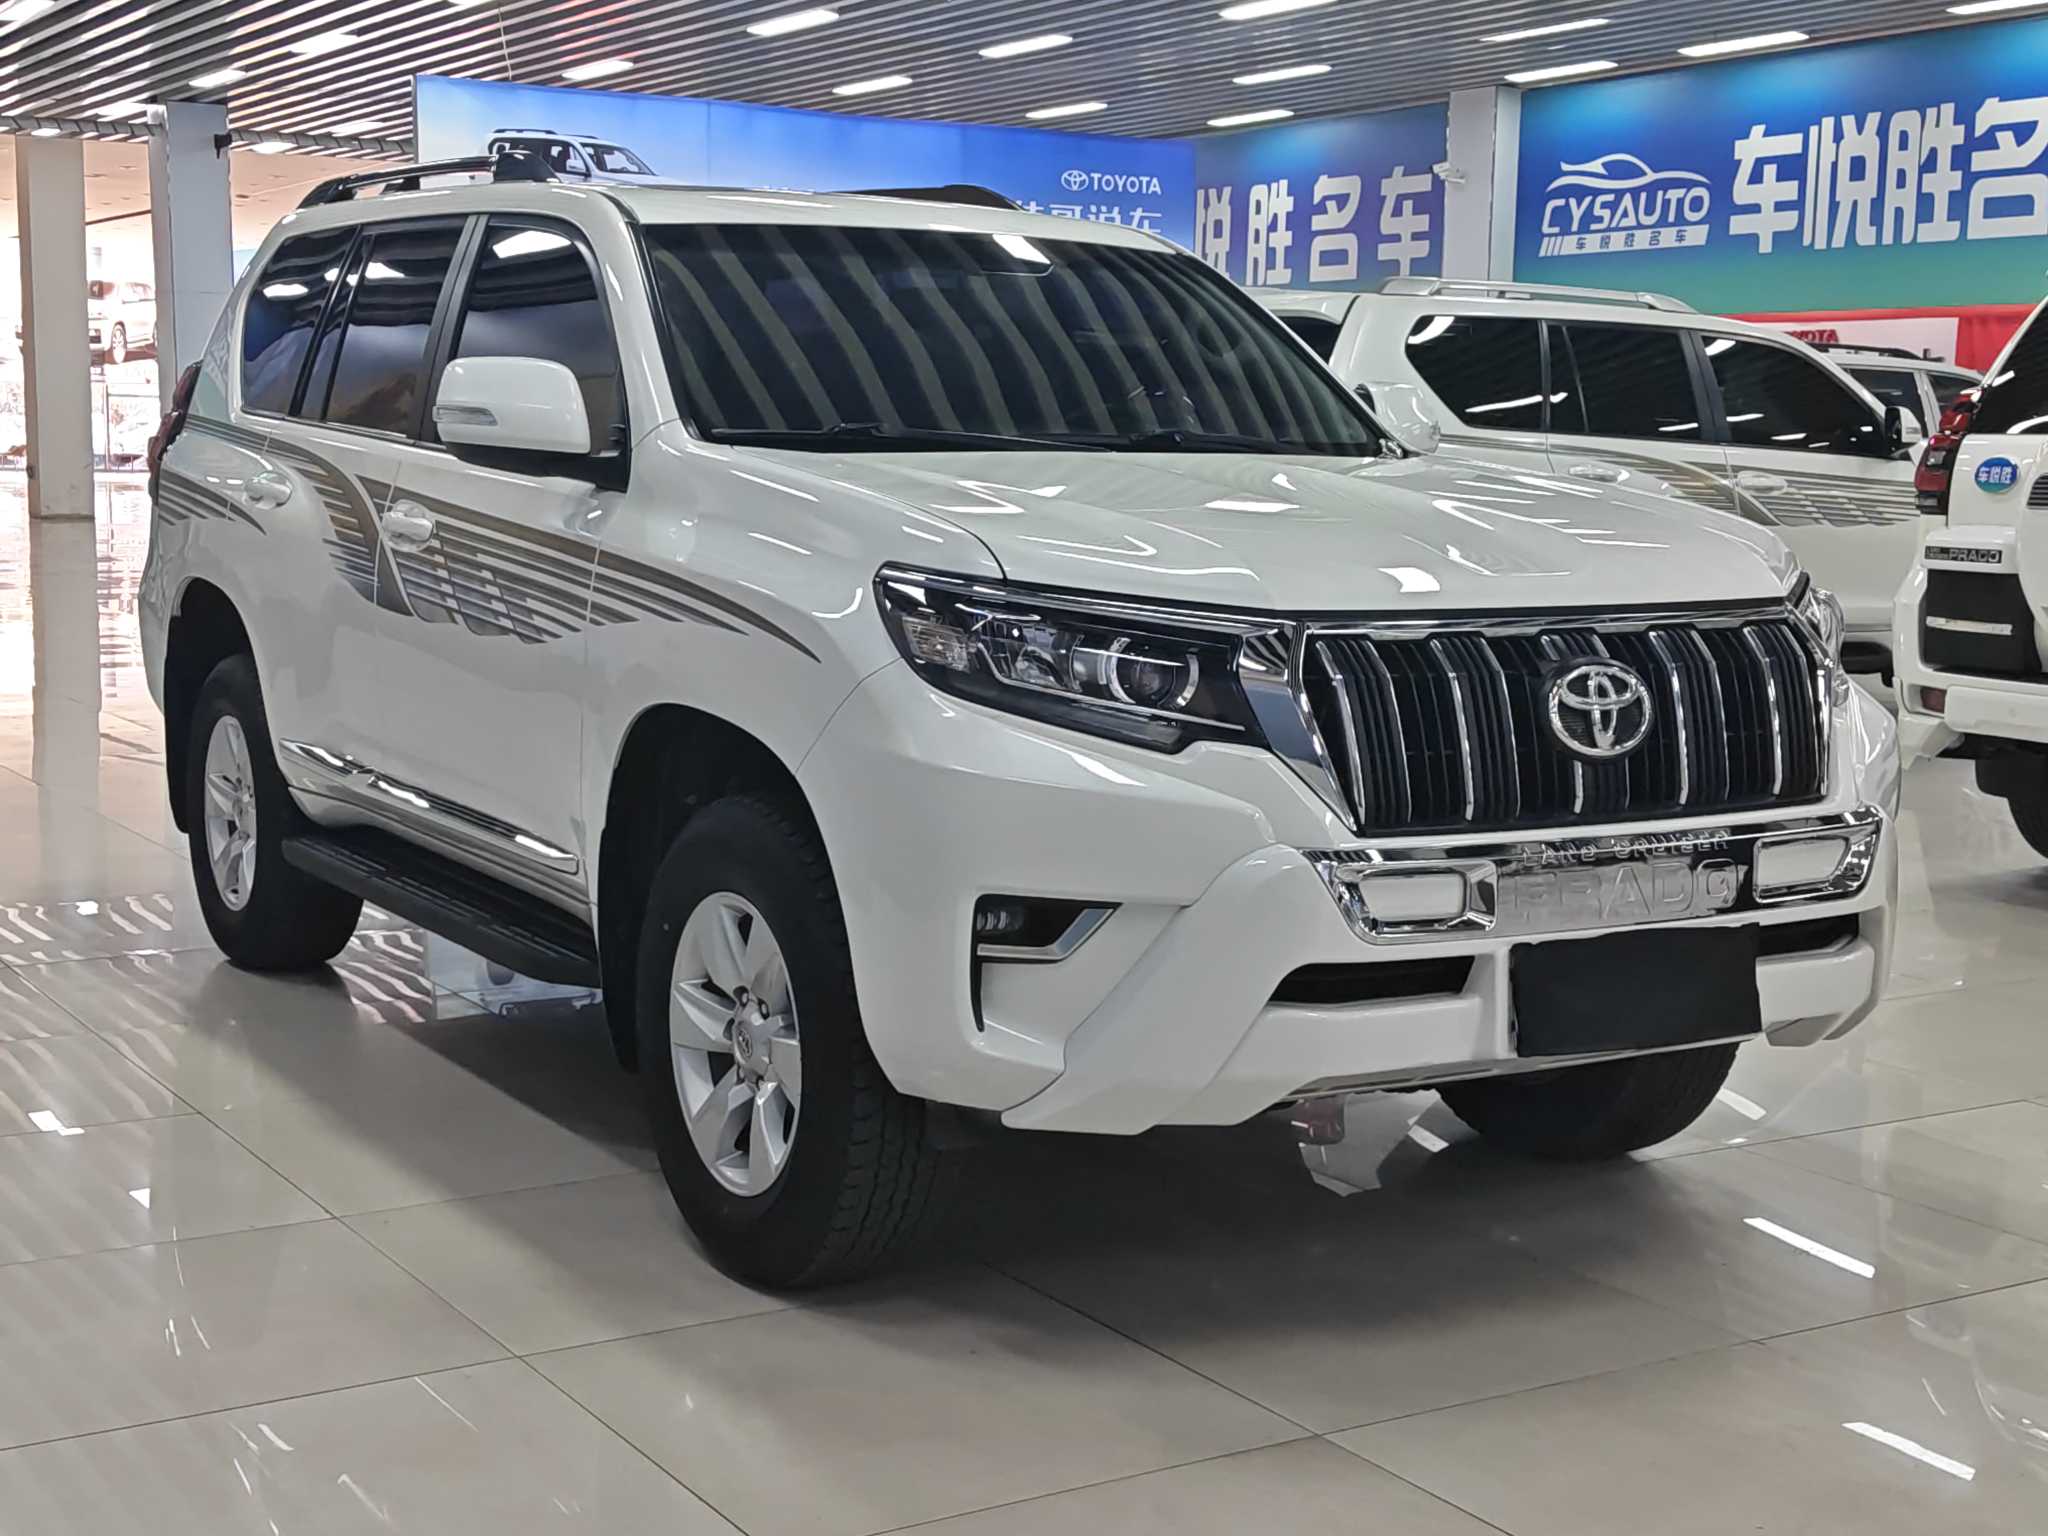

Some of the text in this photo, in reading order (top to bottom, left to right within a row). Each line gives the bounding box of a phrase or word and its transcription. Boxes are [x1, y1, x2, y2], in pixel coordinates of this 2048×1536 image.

[1090, 172, 1162, 195] TOYOTA
[1729, 97, 2048, 254] 车悦胜名
[1016, 199, 1162, 233] 哥说车
[1195, 165, 1433, 286] 悦胜名车
[1541, 186, 1711, 234] CYSAUTO
